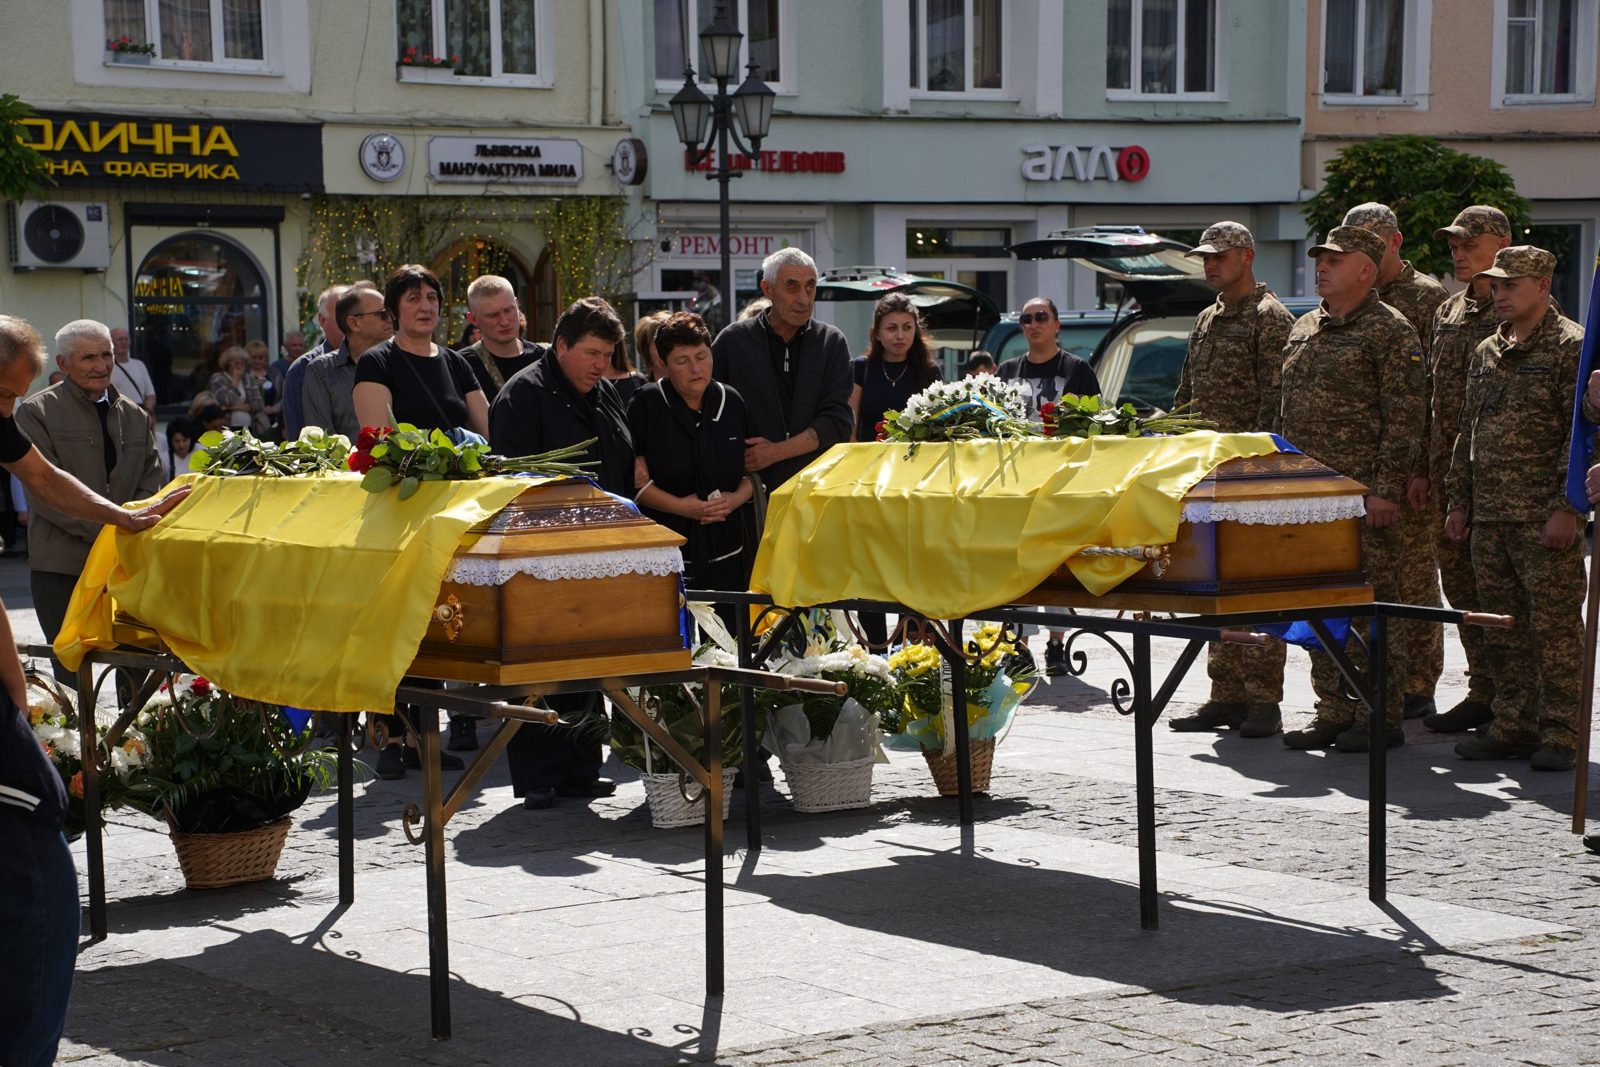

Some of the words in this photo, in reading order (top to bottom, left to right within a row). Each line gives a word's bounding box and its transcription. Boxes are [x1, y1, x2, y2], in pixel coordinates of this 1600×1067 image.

[10, 118, 240, 157] ОЛИЧНА
[474, 144, 542, 159] ЛЬВІВСЬКА
[44, 160, 89, 177] НА
[103, 161, 241, 181] ФАБРИКА
[439, 162, 537, 178] МАНУФАКТУРА
[538, 164, 577, 178] МИЛА
